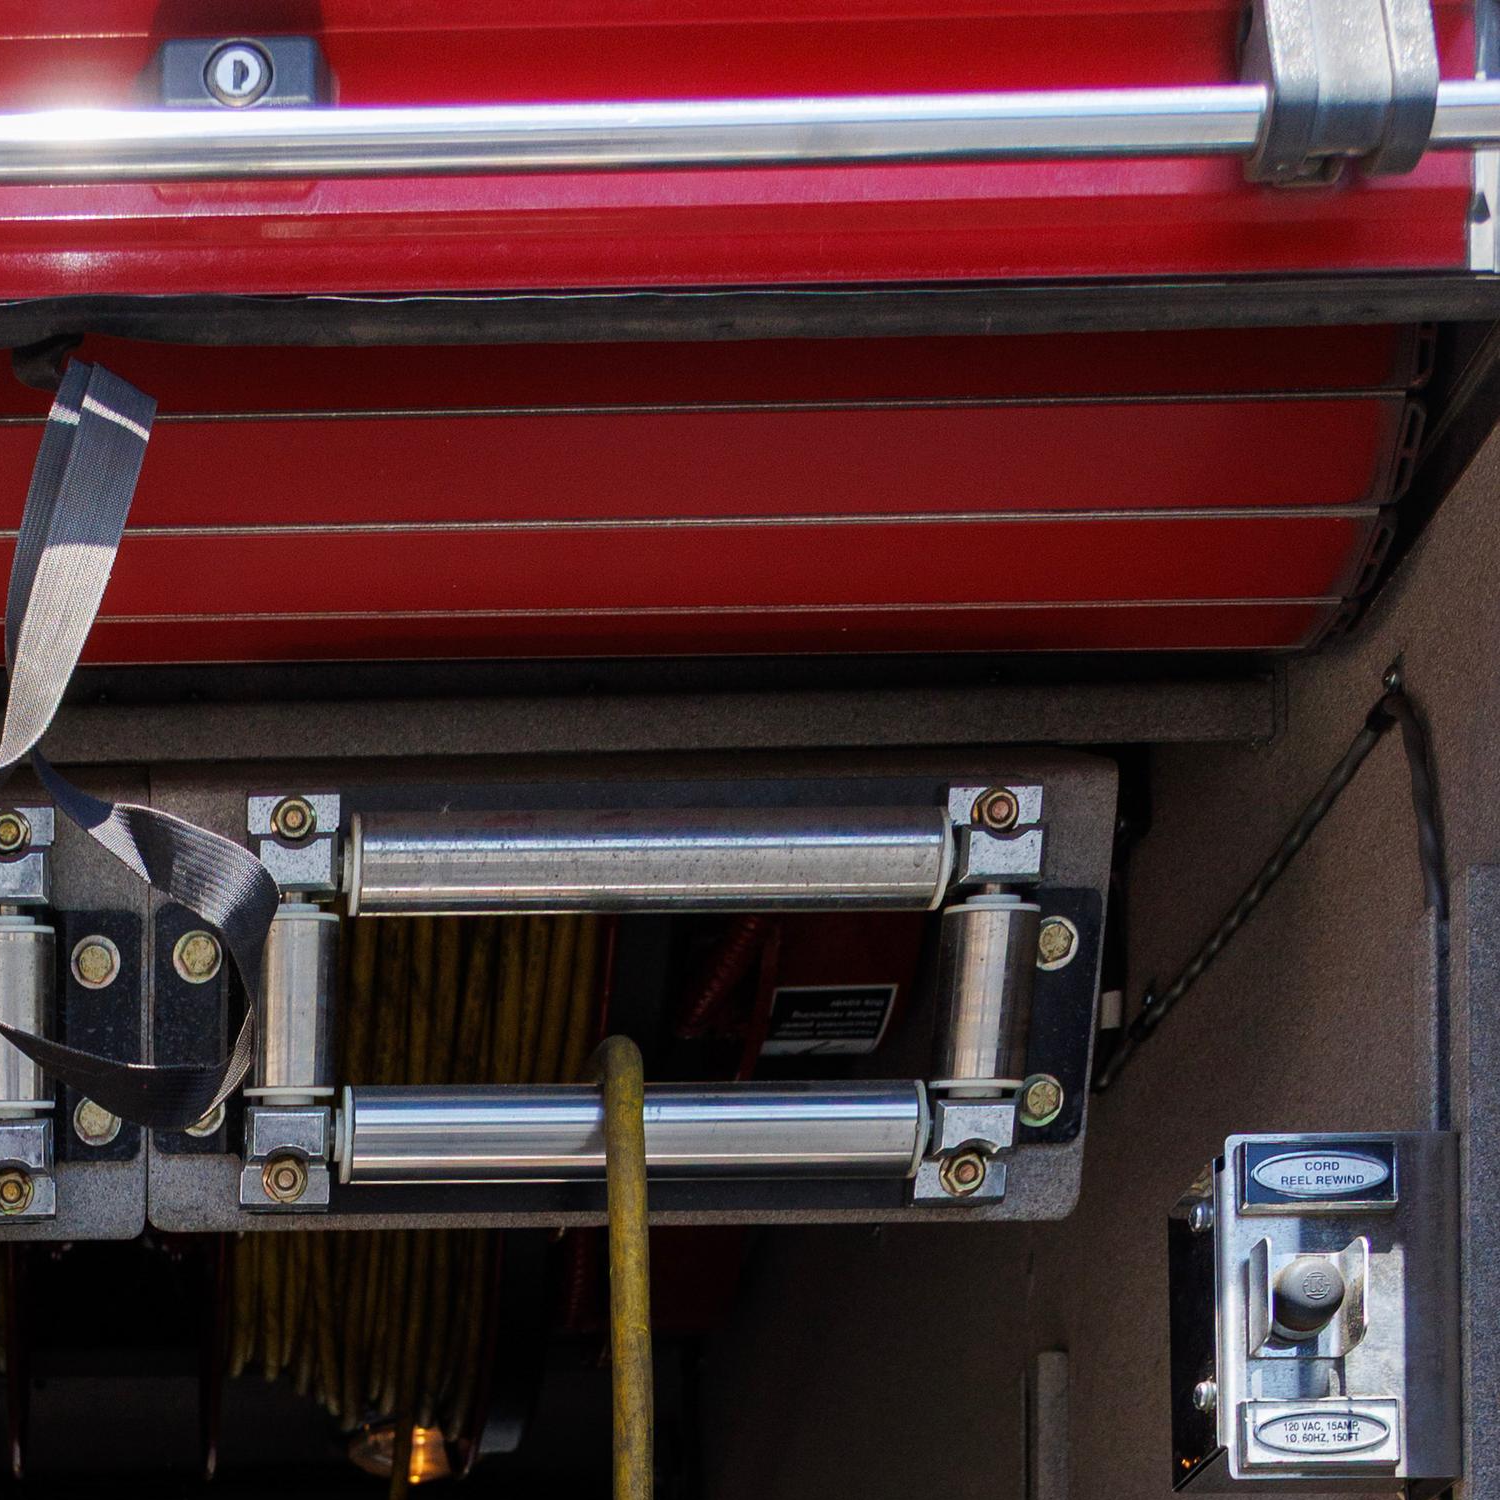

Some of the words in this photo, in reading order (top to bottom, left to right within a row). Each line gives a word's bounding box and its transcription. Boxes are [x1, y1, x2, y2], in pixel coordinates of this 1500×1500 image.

[1305, 1162, 1340, 1171] CORD
[1281, 1176, 1312, 1185] REEL
[1316, 1175, 1365, 1184] REWIND
[1284, 1422, 1300, 1431] 120
[1302, 1421, 1324, 1431] VAC,
[1327, 1420, 1360, 1431] 15AMP,
[1302, 1433, 1329, 1443] 60HZ,
[1333, 1432, 1359, 1441] 150FT
